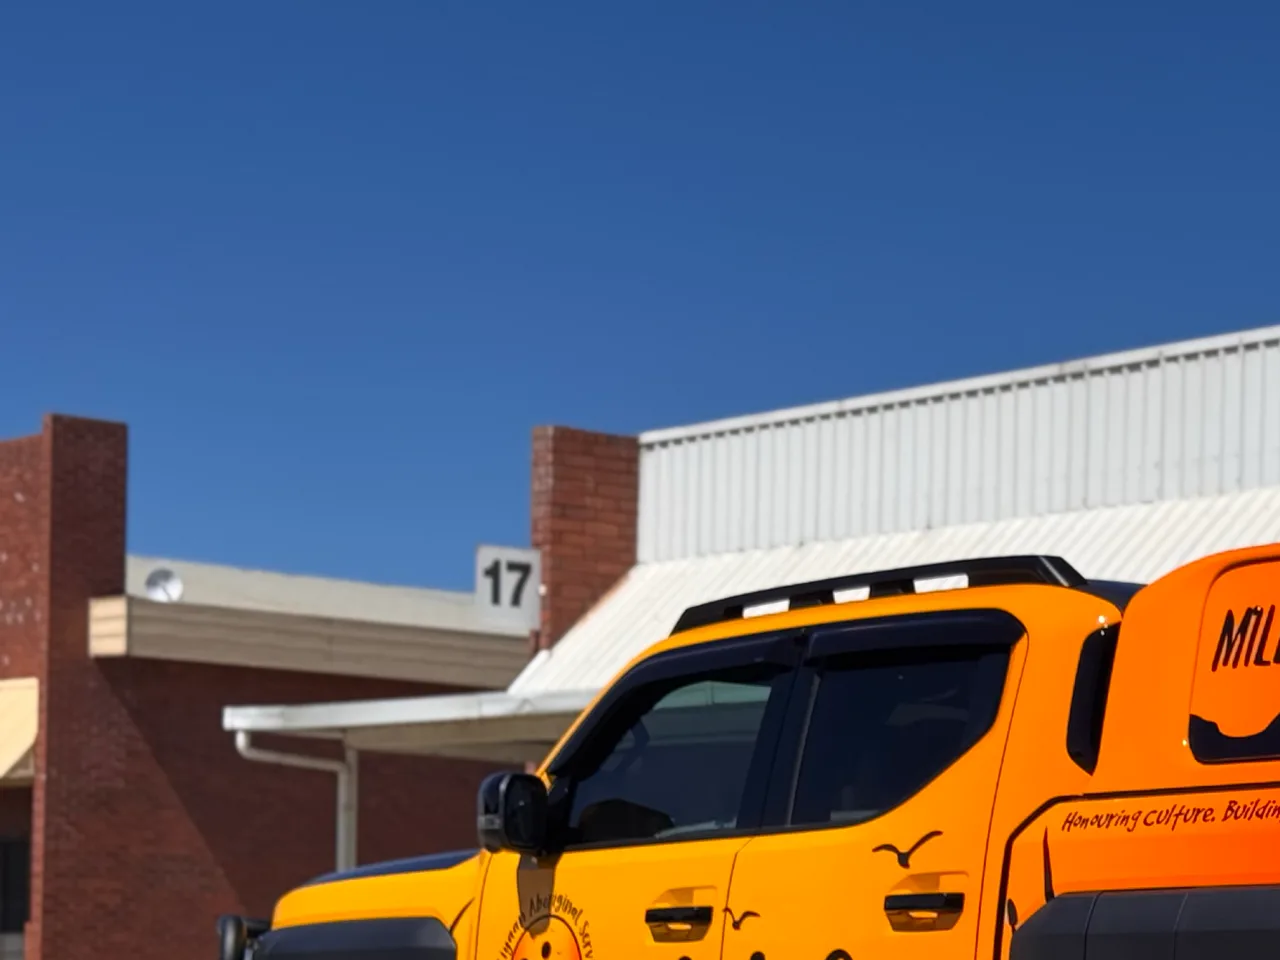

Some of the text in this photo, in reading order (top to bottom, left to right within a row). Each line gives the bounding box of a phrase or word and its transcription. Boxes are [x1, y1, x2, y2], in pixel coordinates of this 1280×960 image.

[483, 558, 532, 608] 17
[1061, 810, 1142, 832] Honouring
[529, 892, 584, 927] Aboriginal
